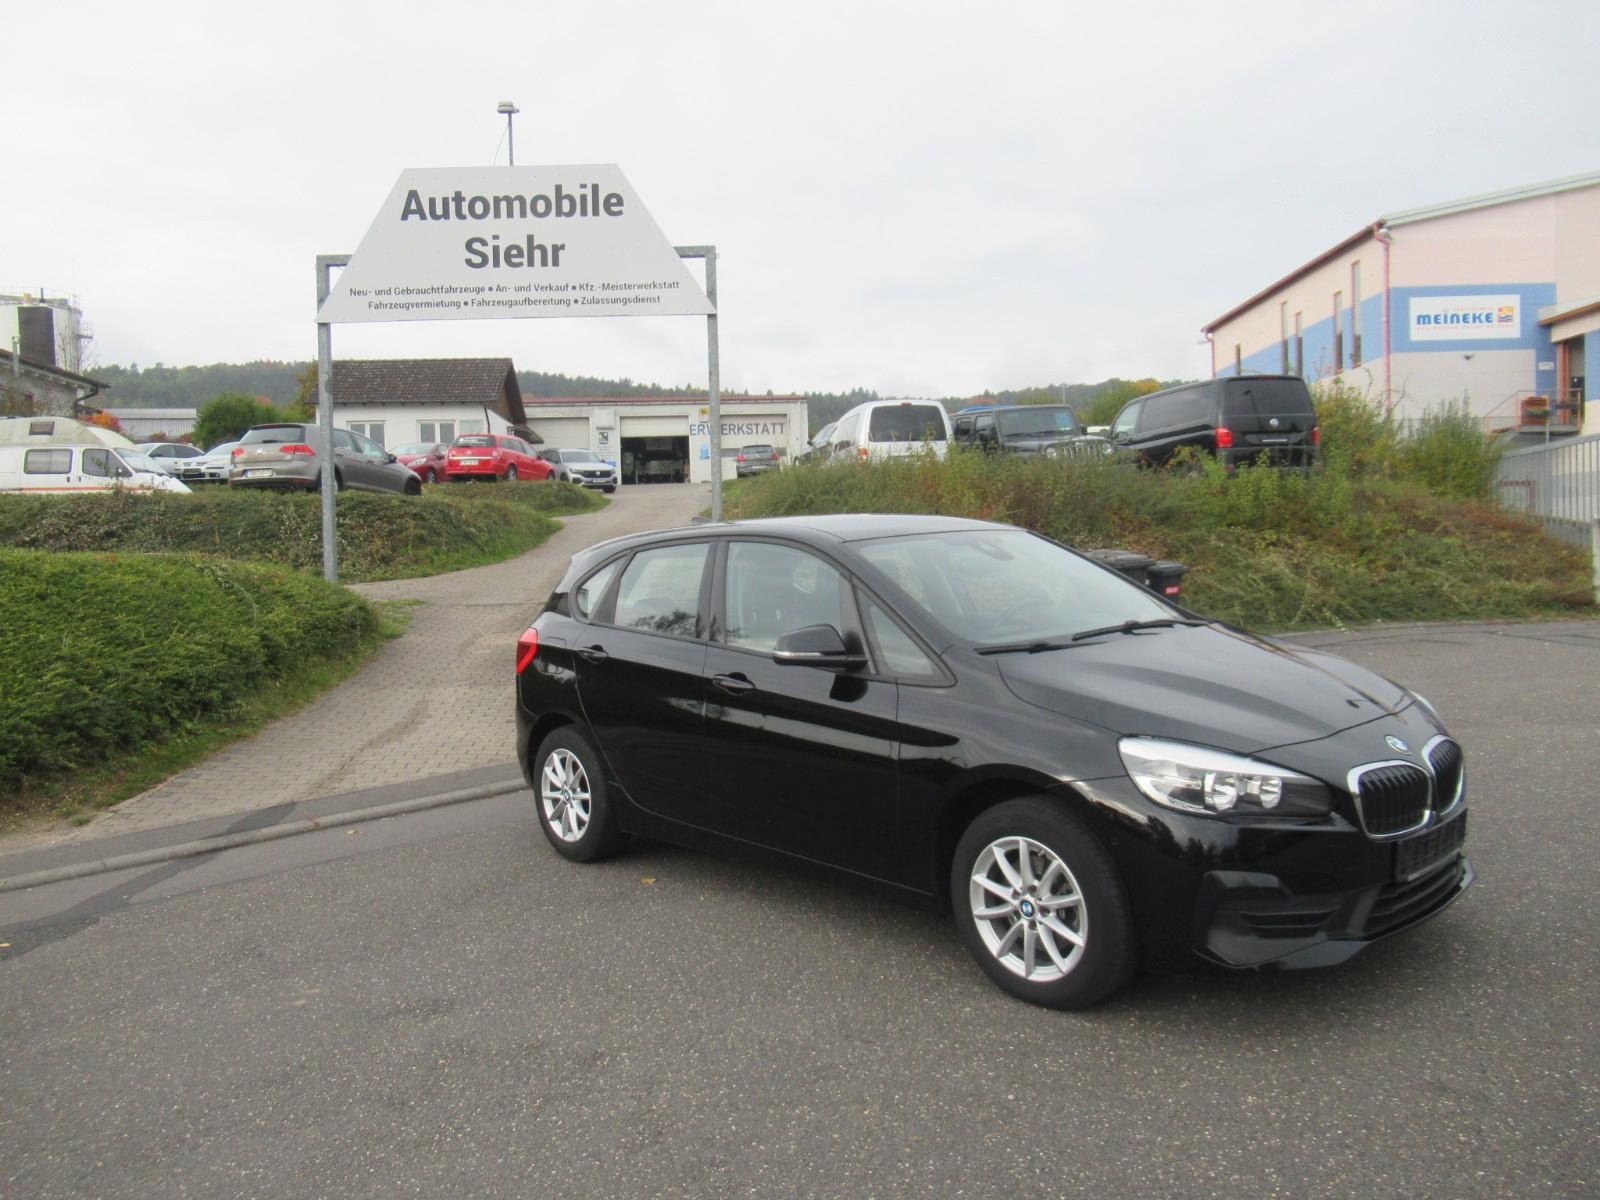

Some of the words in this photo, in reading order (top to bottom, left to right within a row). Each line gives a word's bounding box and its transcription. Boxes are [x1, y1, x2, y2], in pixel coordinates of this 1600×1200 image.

[401, 183, 625, 221] Automobile
[465, 235, 566, 269] Siehr
[349, 288, 373, 297] Neu-
[374, 287, 392, 297] und
[394, 284, 486, 297] Gebrauchtfahrzeuge
[496, 284, 512, 293] An-
[514, 283, 532, 293] und
[533, 282, 569, 292] Verkauf
[368, 300, 462, 311] Fahrzeugvermietung
[471, 297, 571, 309] Fahrzeugaufbereitung
[580, 295, 661, 306] Zulassungsdienst
